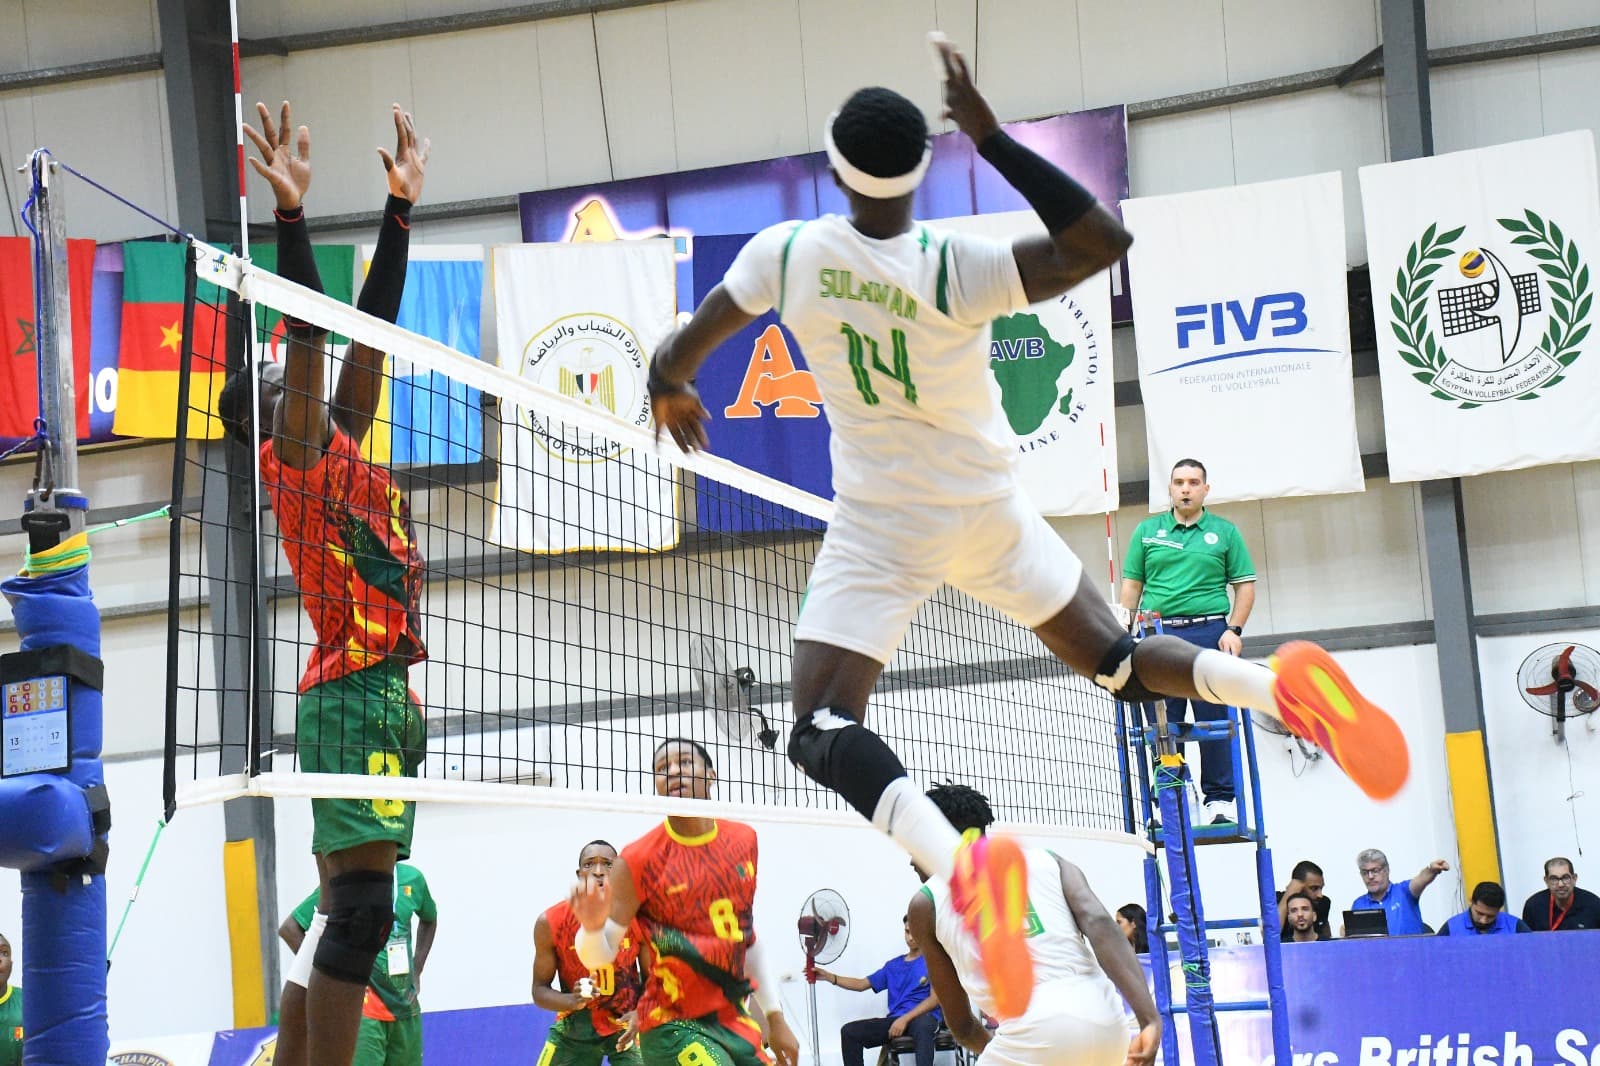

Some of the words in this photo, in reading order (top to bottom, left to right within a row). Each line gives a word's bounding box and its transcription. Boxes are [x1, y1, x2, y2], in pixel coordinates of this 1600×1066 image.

[577, 320, 626, 341] الشباب
[1175, 291, 1308, 349] FIVB
[530, 325, 575, 366] والرياضة
[624, 338, 641, 368] وزارة
[990, 337, 1045, 361] AVB
[1060, 294, 1097, 386] VOLLEYBAL
[841, 321, 918, 406] 14
[1236, 361, 1313, 380] INTERNATIONALE
[1211, 384, 1224, 393] DE
[1225, 376, 1281, 392] VOLLEYBALL
[1442, 377, 1473, 396] EGYPTIAN
[1474, 388, 1515, 398] VOLLEYBALL
[1516, 364, 1553, 390] FEDERATION
[634, 394, 650, 426] PORTS
[1069, 401, 1086, 423] DE
[1359, 1031, 1533, 1066] British
